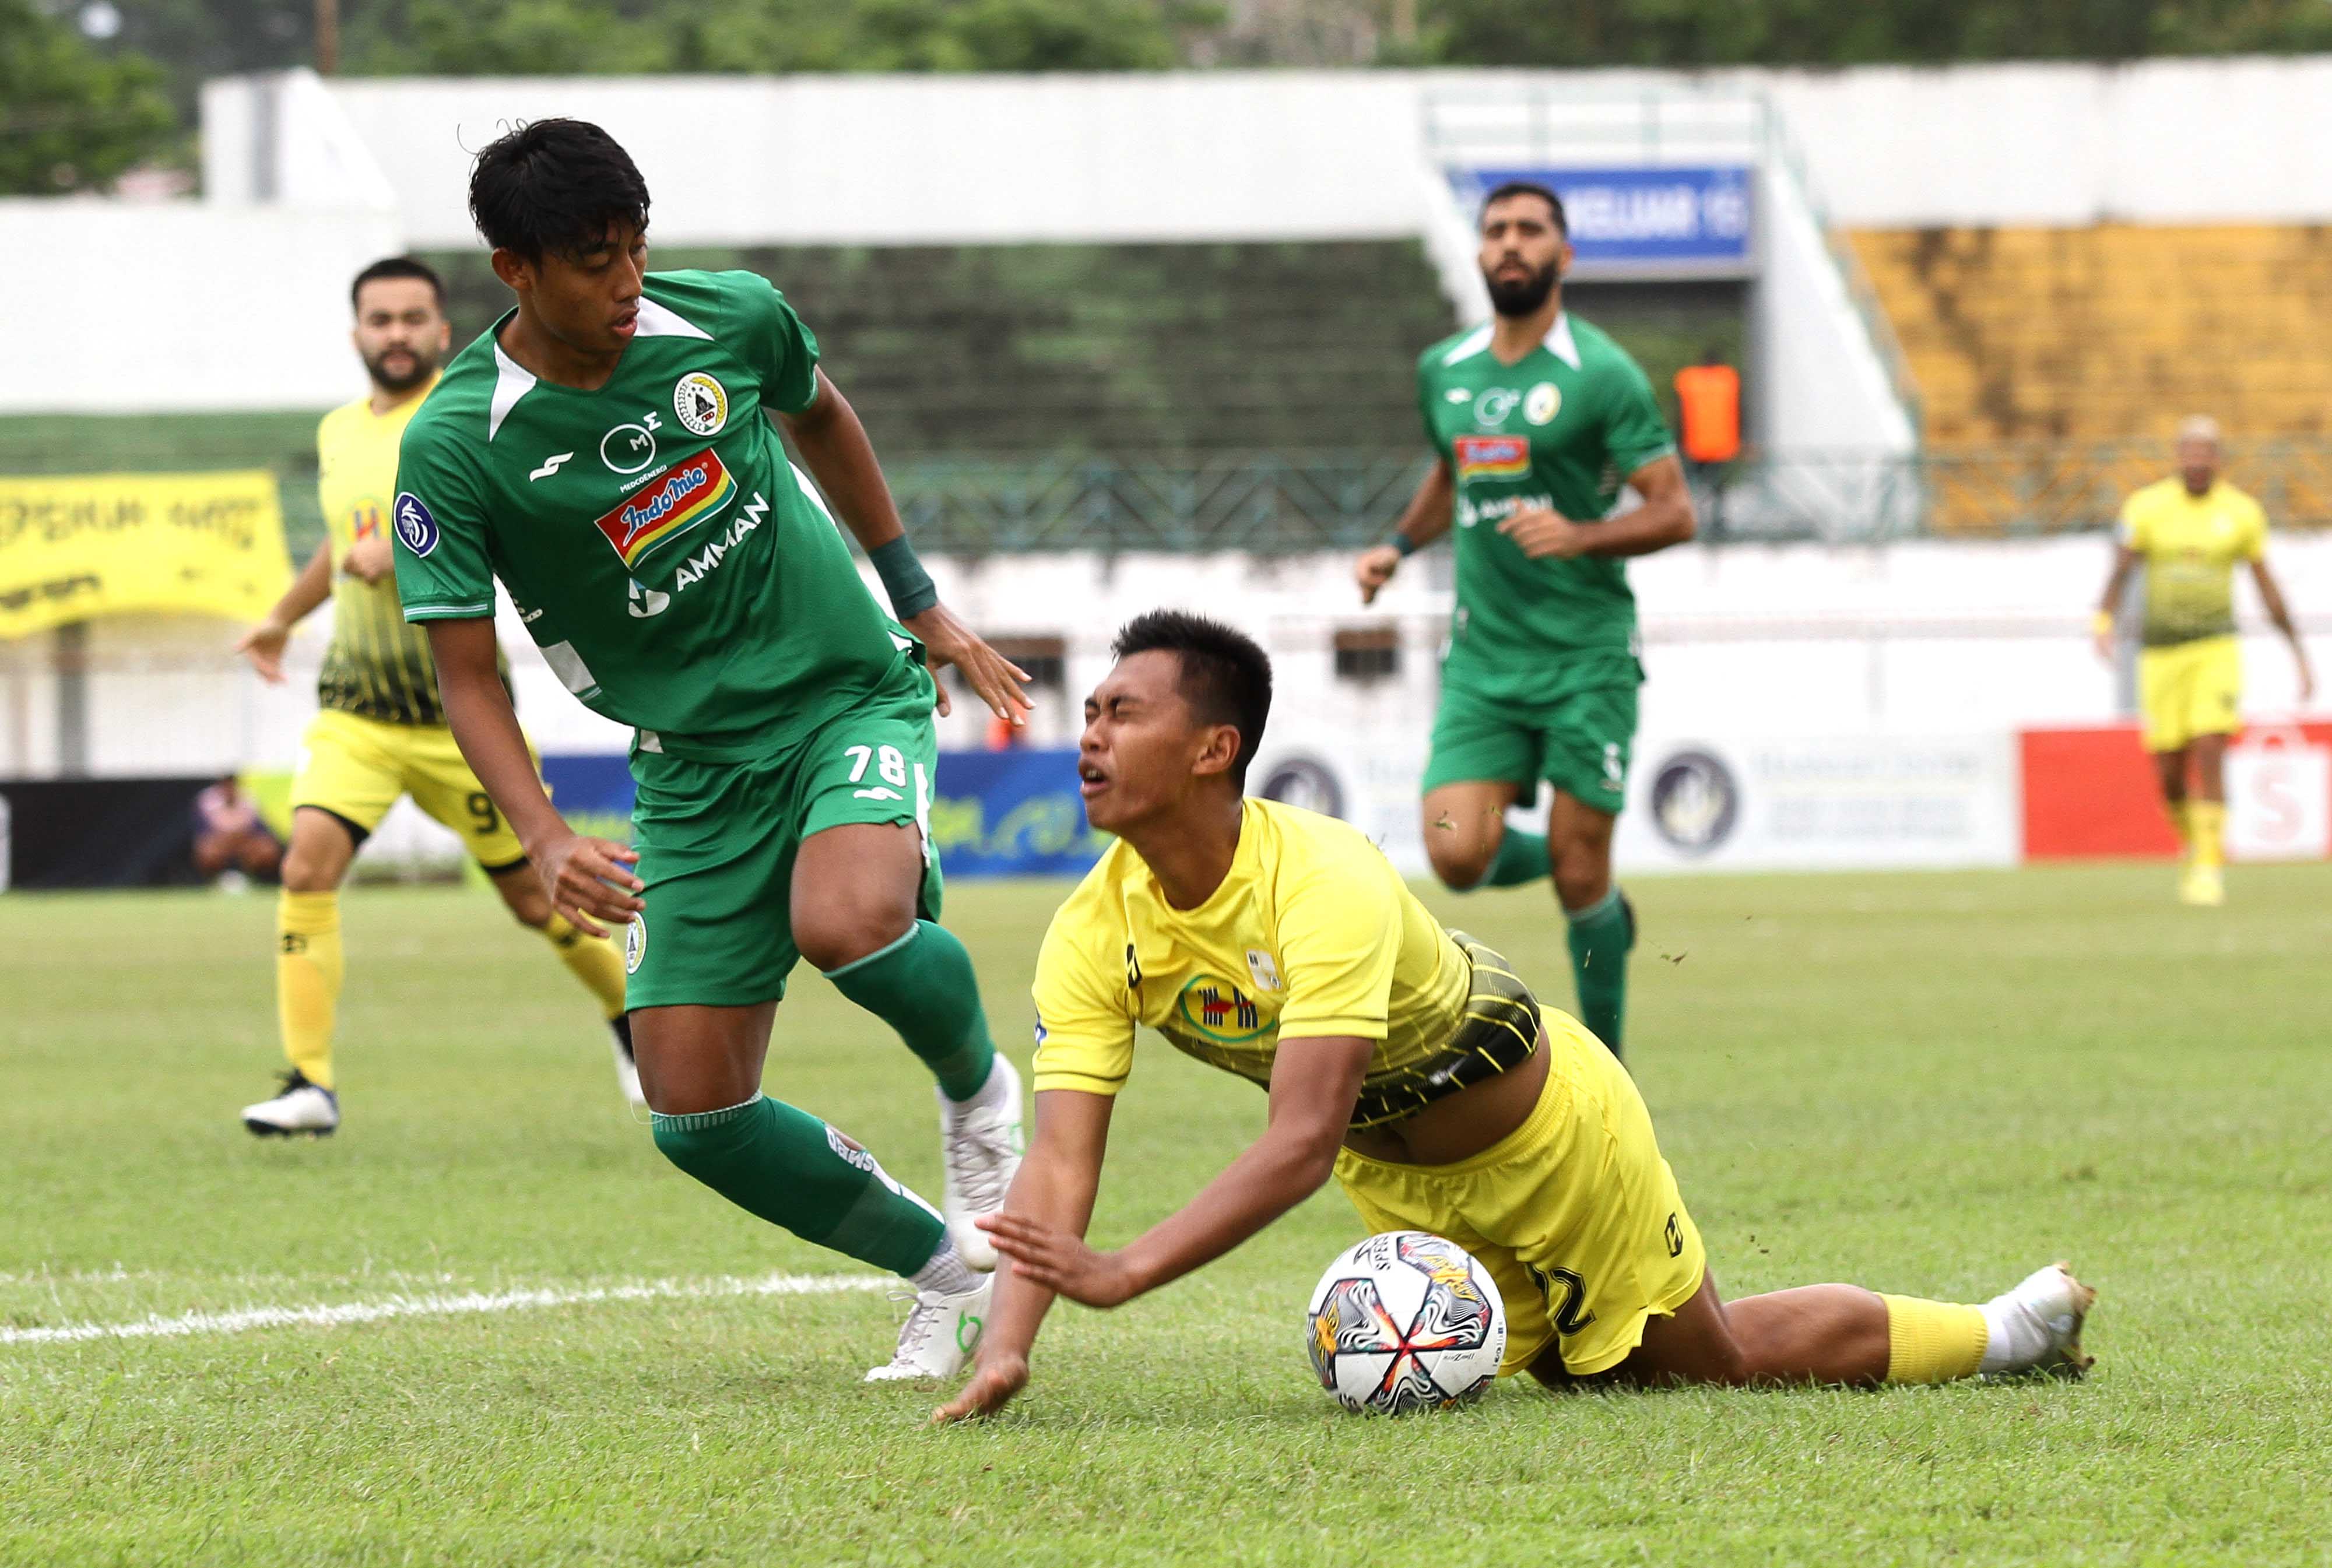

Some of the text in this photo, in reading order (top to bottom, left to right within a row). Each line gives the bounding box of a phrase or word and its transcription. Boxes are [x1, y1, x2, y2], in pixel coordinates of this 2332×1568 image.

[676, 491, 770, 592] AMMAN
[844, 744, 907, 788] 78
[467, 792, 499, 835] 9
